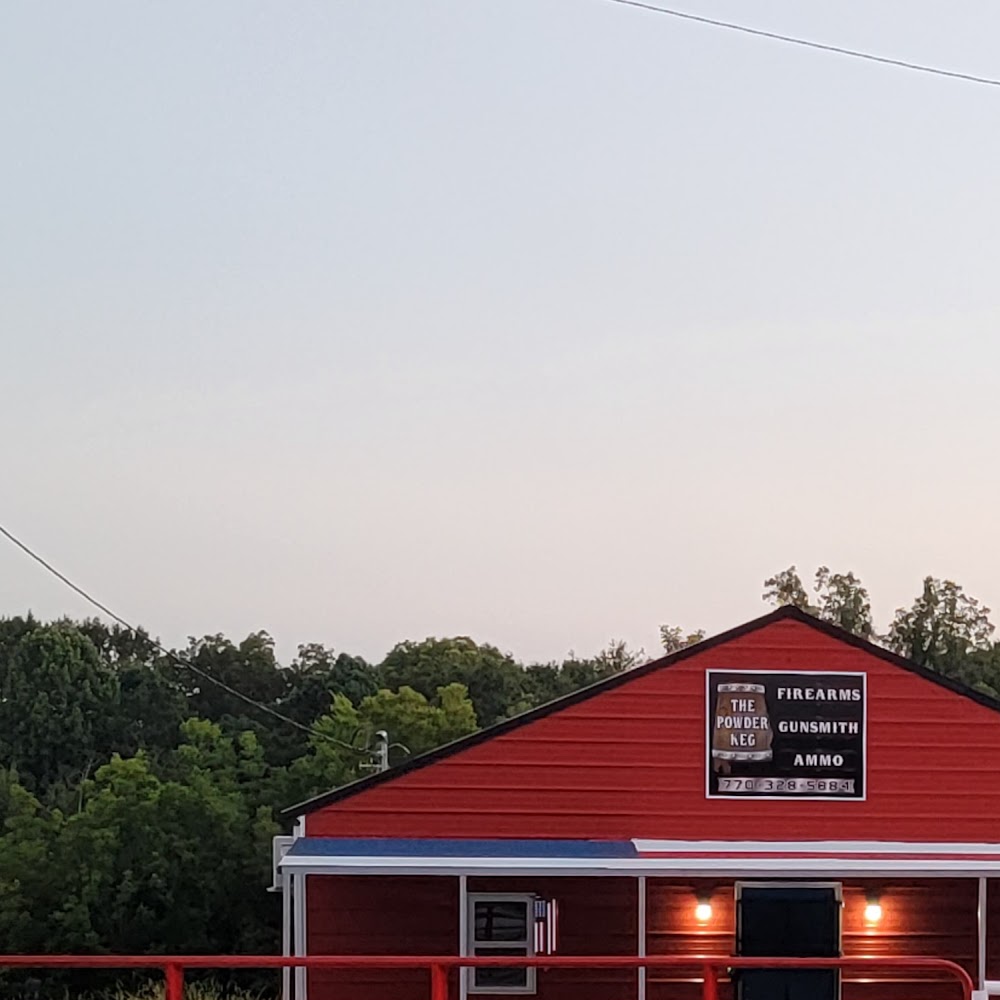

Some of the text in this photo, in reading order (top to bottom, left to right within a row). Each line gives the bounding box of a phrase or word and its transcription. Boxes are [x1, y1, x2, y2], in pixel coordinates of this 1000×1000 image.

[777, 687, 861, 701] FIREARMS
[730, 699, 755, 712] THE
[717, 716, 768, 730] POWDER
[778, 721, 859, 734] GUNSMITH
[730, 733, 756, 746] KEG
[793, 754, 844, 767] AMMO
